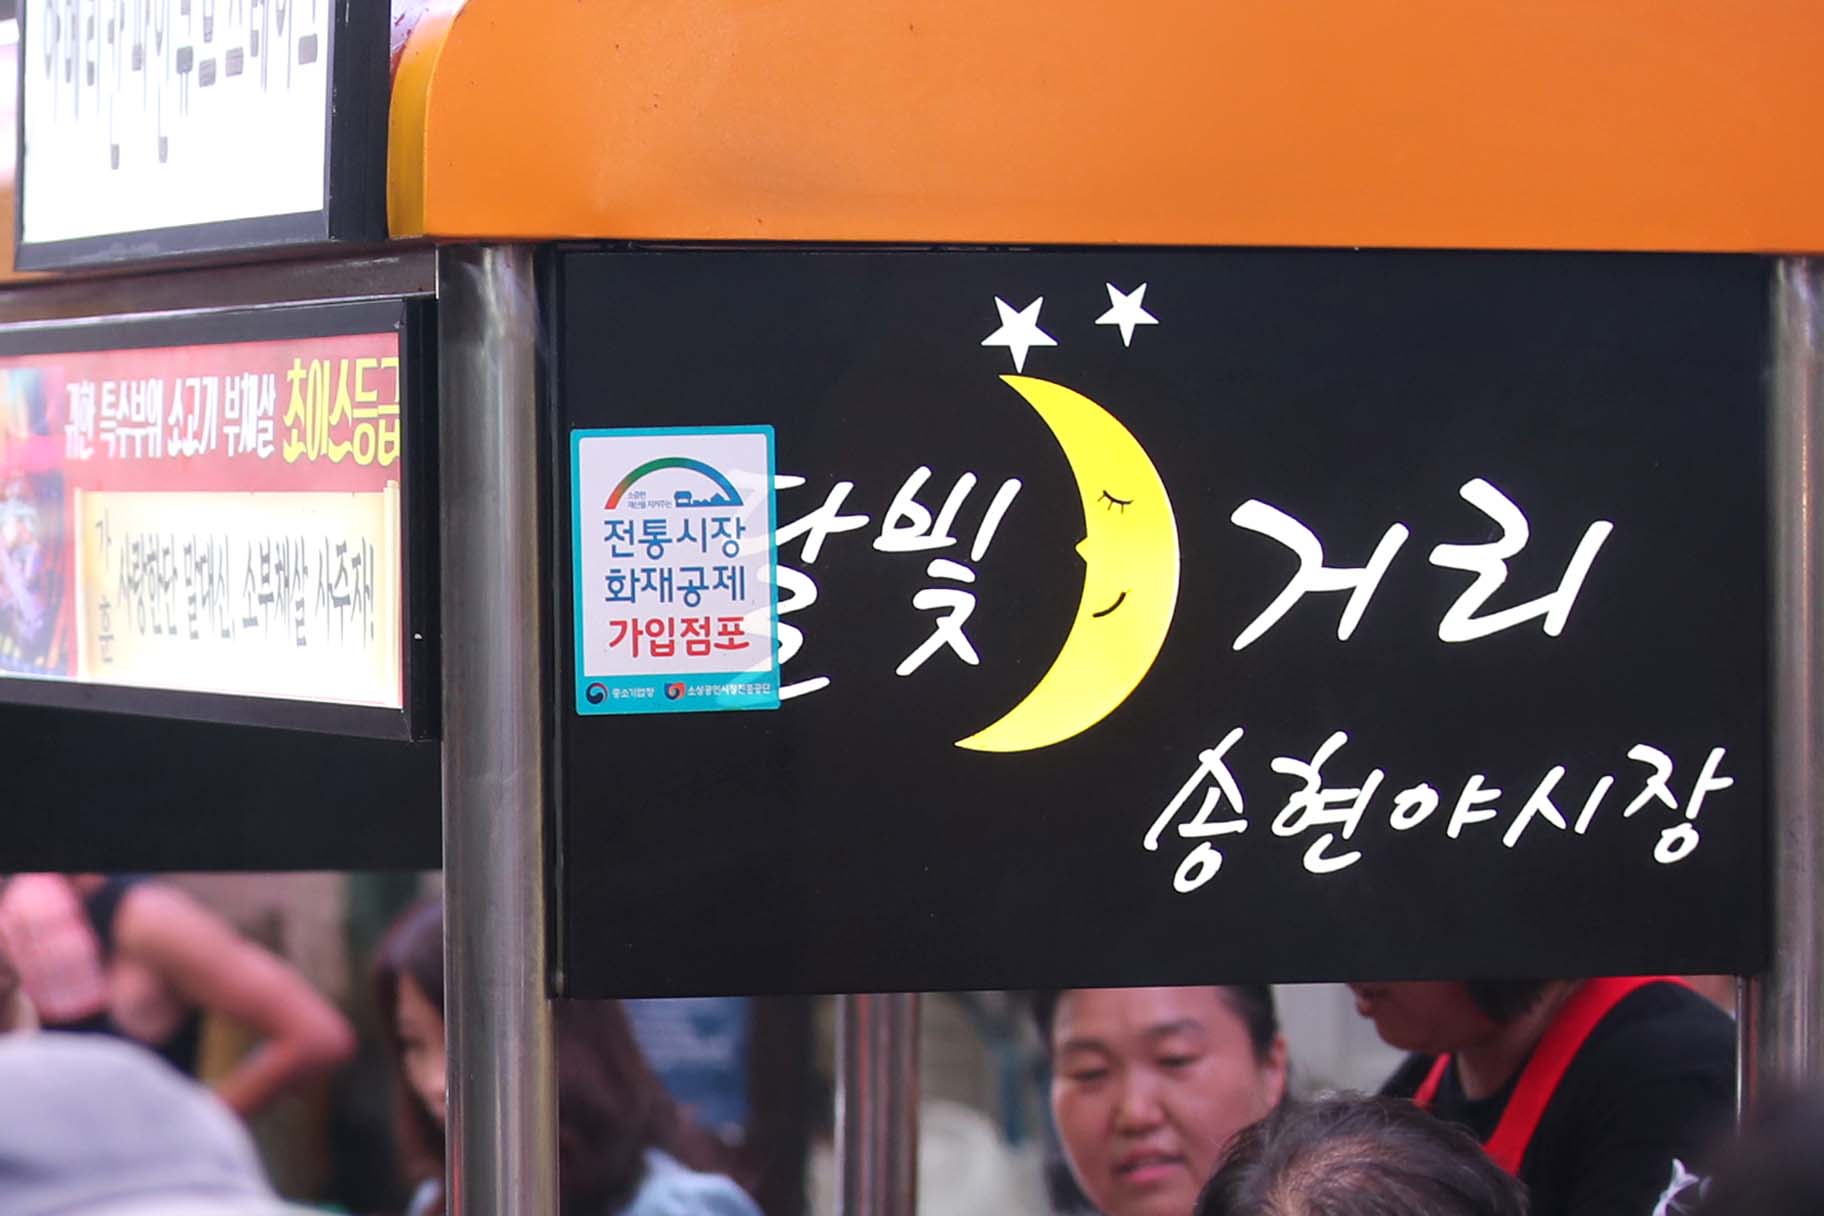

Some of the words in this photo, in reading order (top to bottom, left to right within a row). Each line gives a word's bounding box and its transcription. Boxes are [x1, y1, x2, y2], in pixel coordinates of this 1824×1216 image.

[99, 377, 165, 460] 특수부위
[167, 375, 220, 458] 소고기
[222, 371, 277, 459] 부채살
[282, 356, 401, 467] 초이스등급
[603, 516, 746, 561] 전통시장
[604, 565, 746, 608] 화재공제
[748, 466, 1023, 702] 달빛
[1231, 479, 1613, 650] 거리
[608, 615, 751, 659] 가입점포
[1144, 728, 1733, 892] 송현야시장
